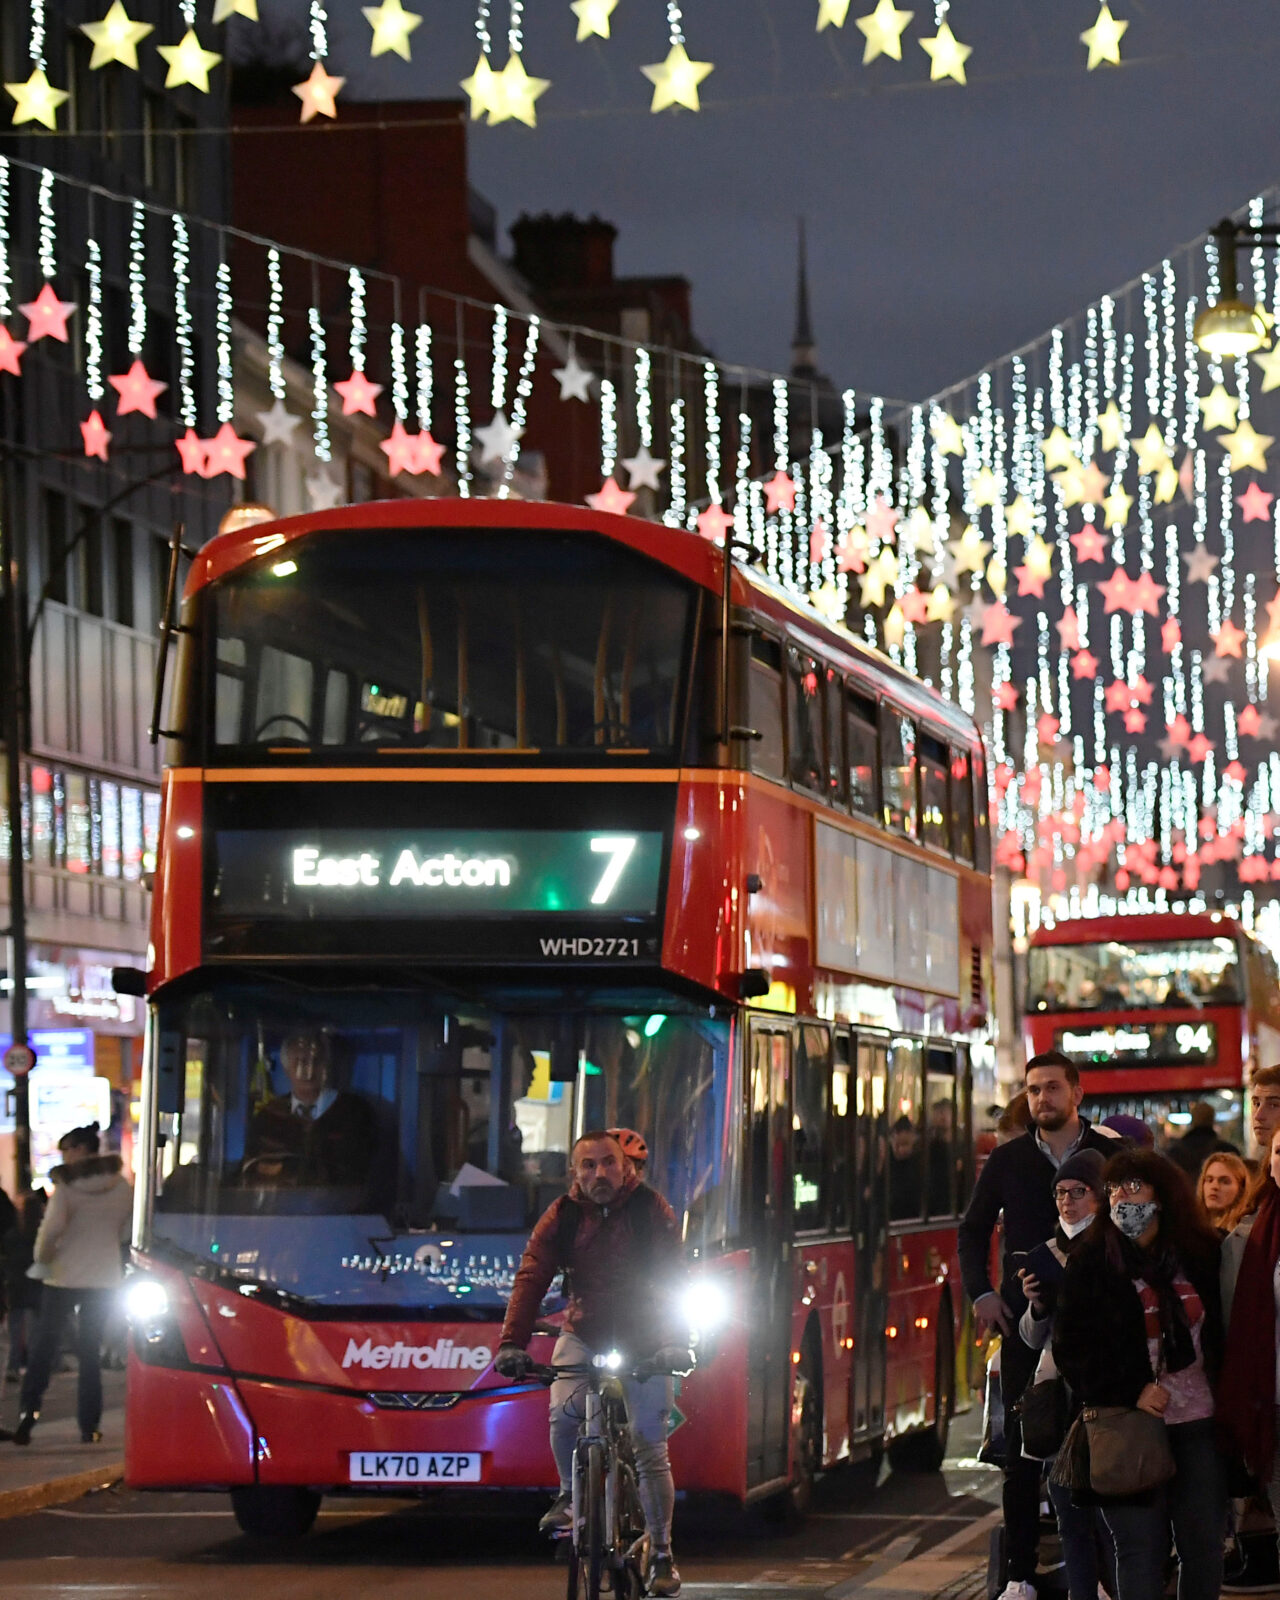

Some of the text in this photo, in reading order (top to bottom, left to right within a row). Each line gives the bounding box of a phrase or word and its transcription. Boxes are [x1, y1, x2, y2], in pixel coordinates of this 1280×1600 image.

[293, 837, 637, 905] East Acton 7
[539, 938, 639, 957] WHD2721
[1175, 1024, 1212, 1055] 94
[342, 1338, 493, 1370] Metroline
[360, 1456, 470, 1477] LK70 AZP
